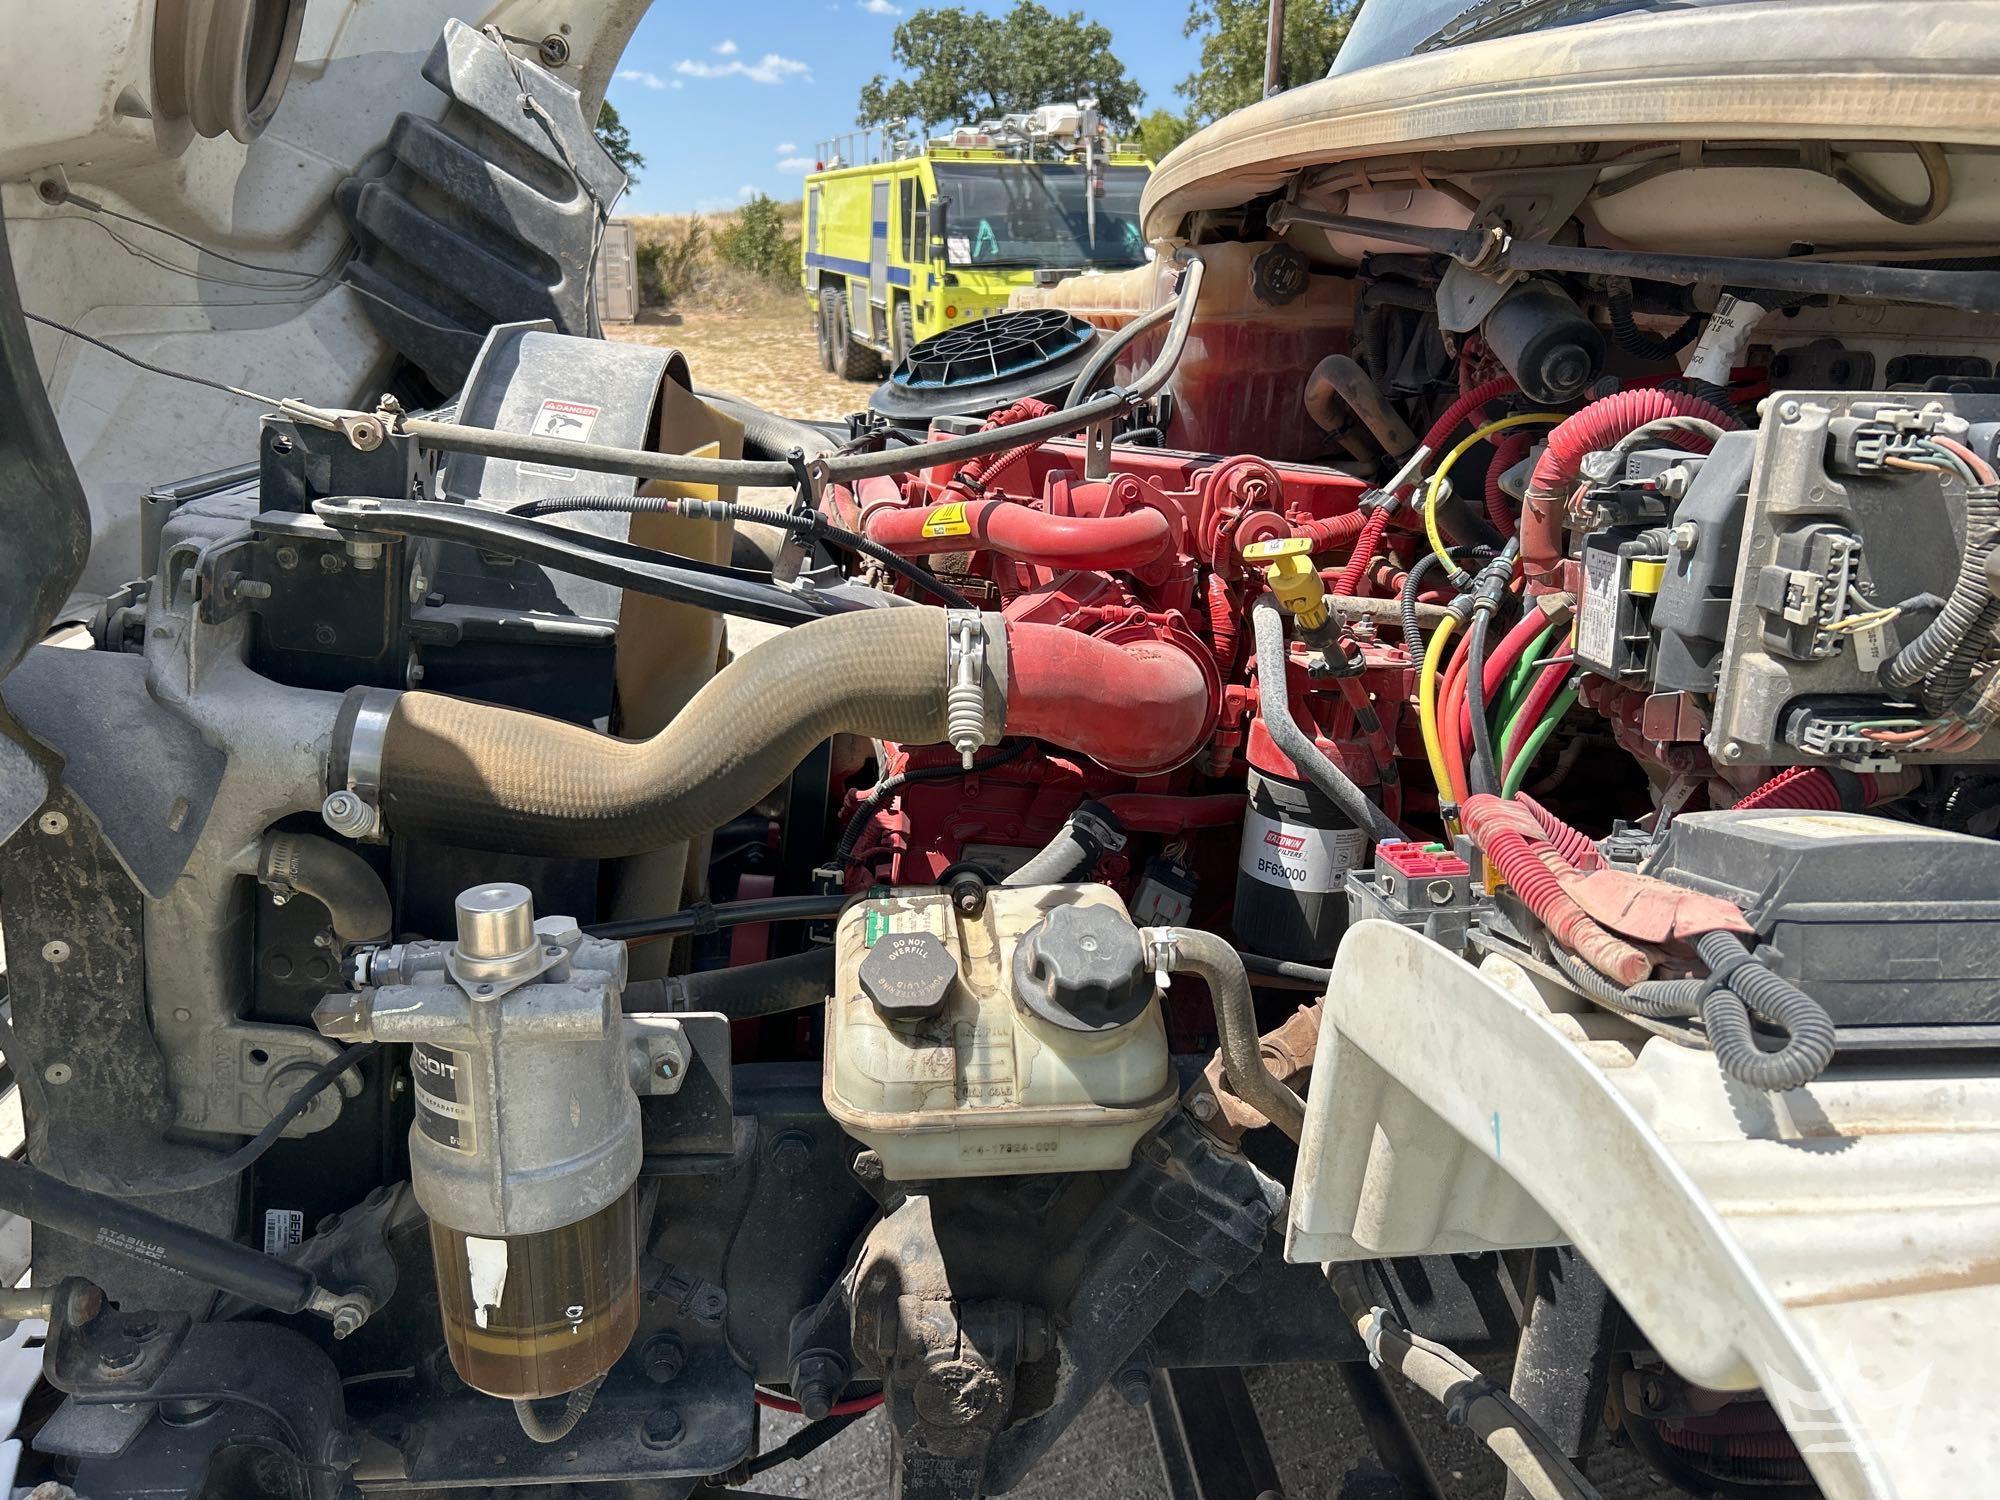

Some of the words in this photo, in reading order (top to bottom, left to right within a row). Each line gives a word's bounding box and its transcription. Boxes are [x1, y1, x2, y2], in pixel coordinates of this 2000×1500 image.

[972, 219, 999, 257] A
[556, 403, 596, 416] DANGER
[1267, 831, 1302, 849] BALDWIN
[1278, 848, 1302, 858] FILTERS
[1258, 858, 1306, 881] BF63000
[893, 939, 905, 949] DO
[908, 939, 926, 948] NOT
[889, 946, 928, 961] OVERFILL
[426, 1097, 466, 1116] SEPARATOR
[290, 1214, 301, 1245] BEHR
[98, 1226, 166, 1254] STABILUS
